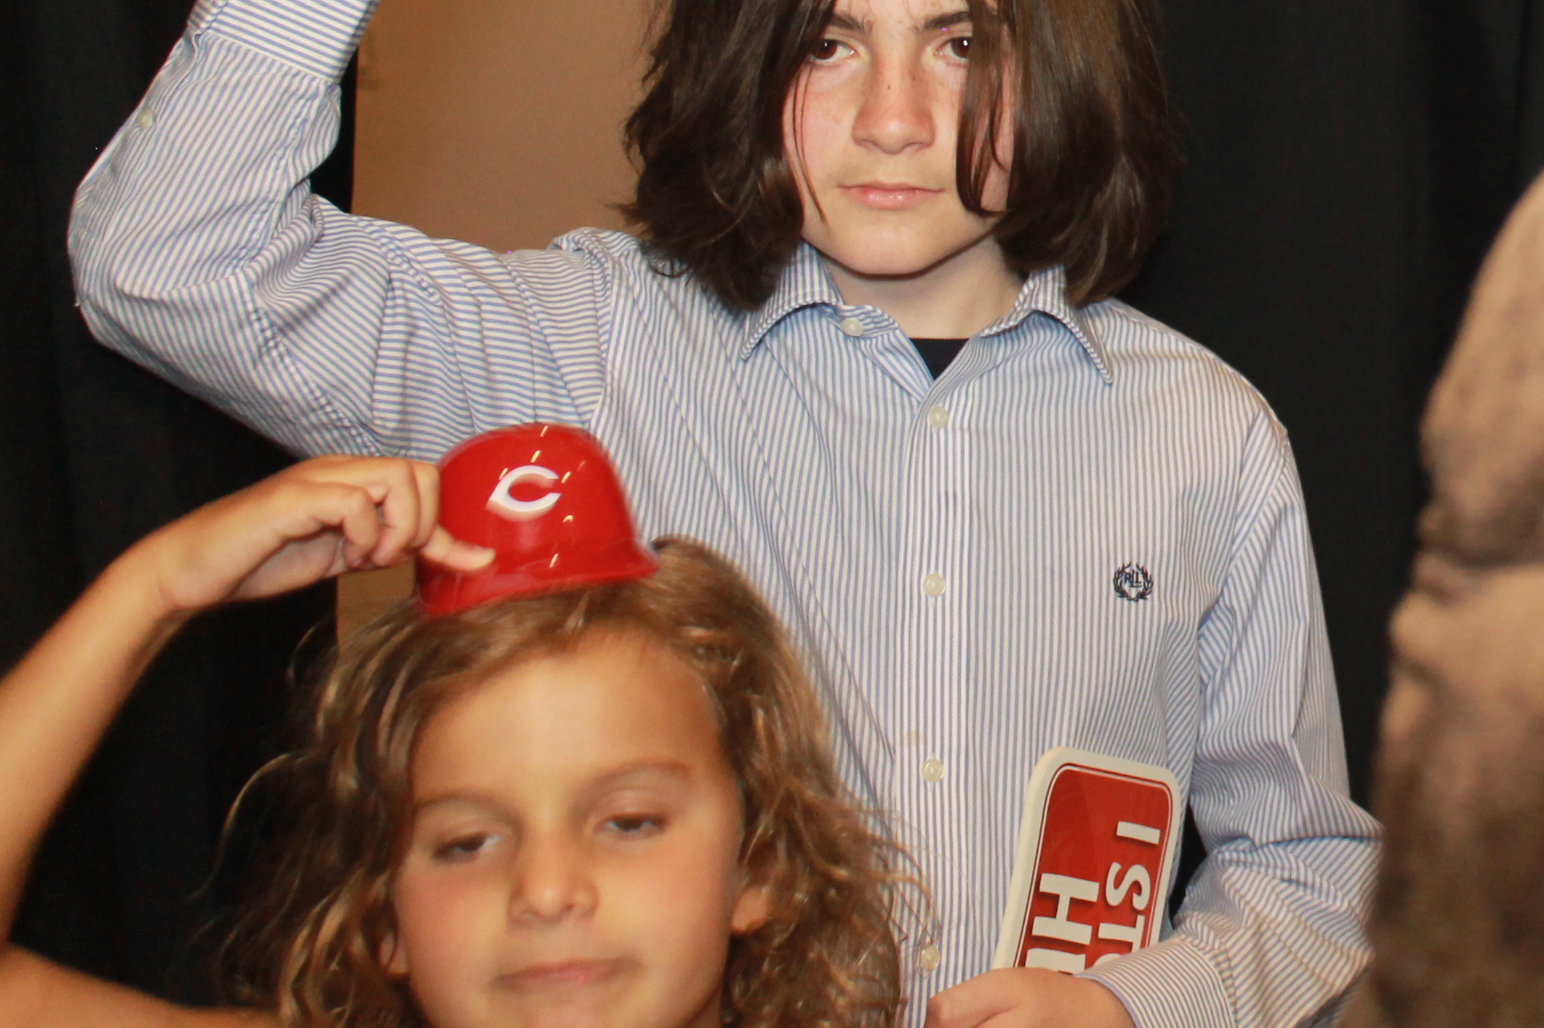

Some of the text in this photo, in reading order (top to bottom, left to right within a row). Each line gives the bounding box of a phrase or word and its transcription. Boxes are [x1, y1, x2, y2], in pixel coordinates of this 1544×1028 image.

[488, 464, 562, 513] C
[1092, 820, 1161, 969] I ST
